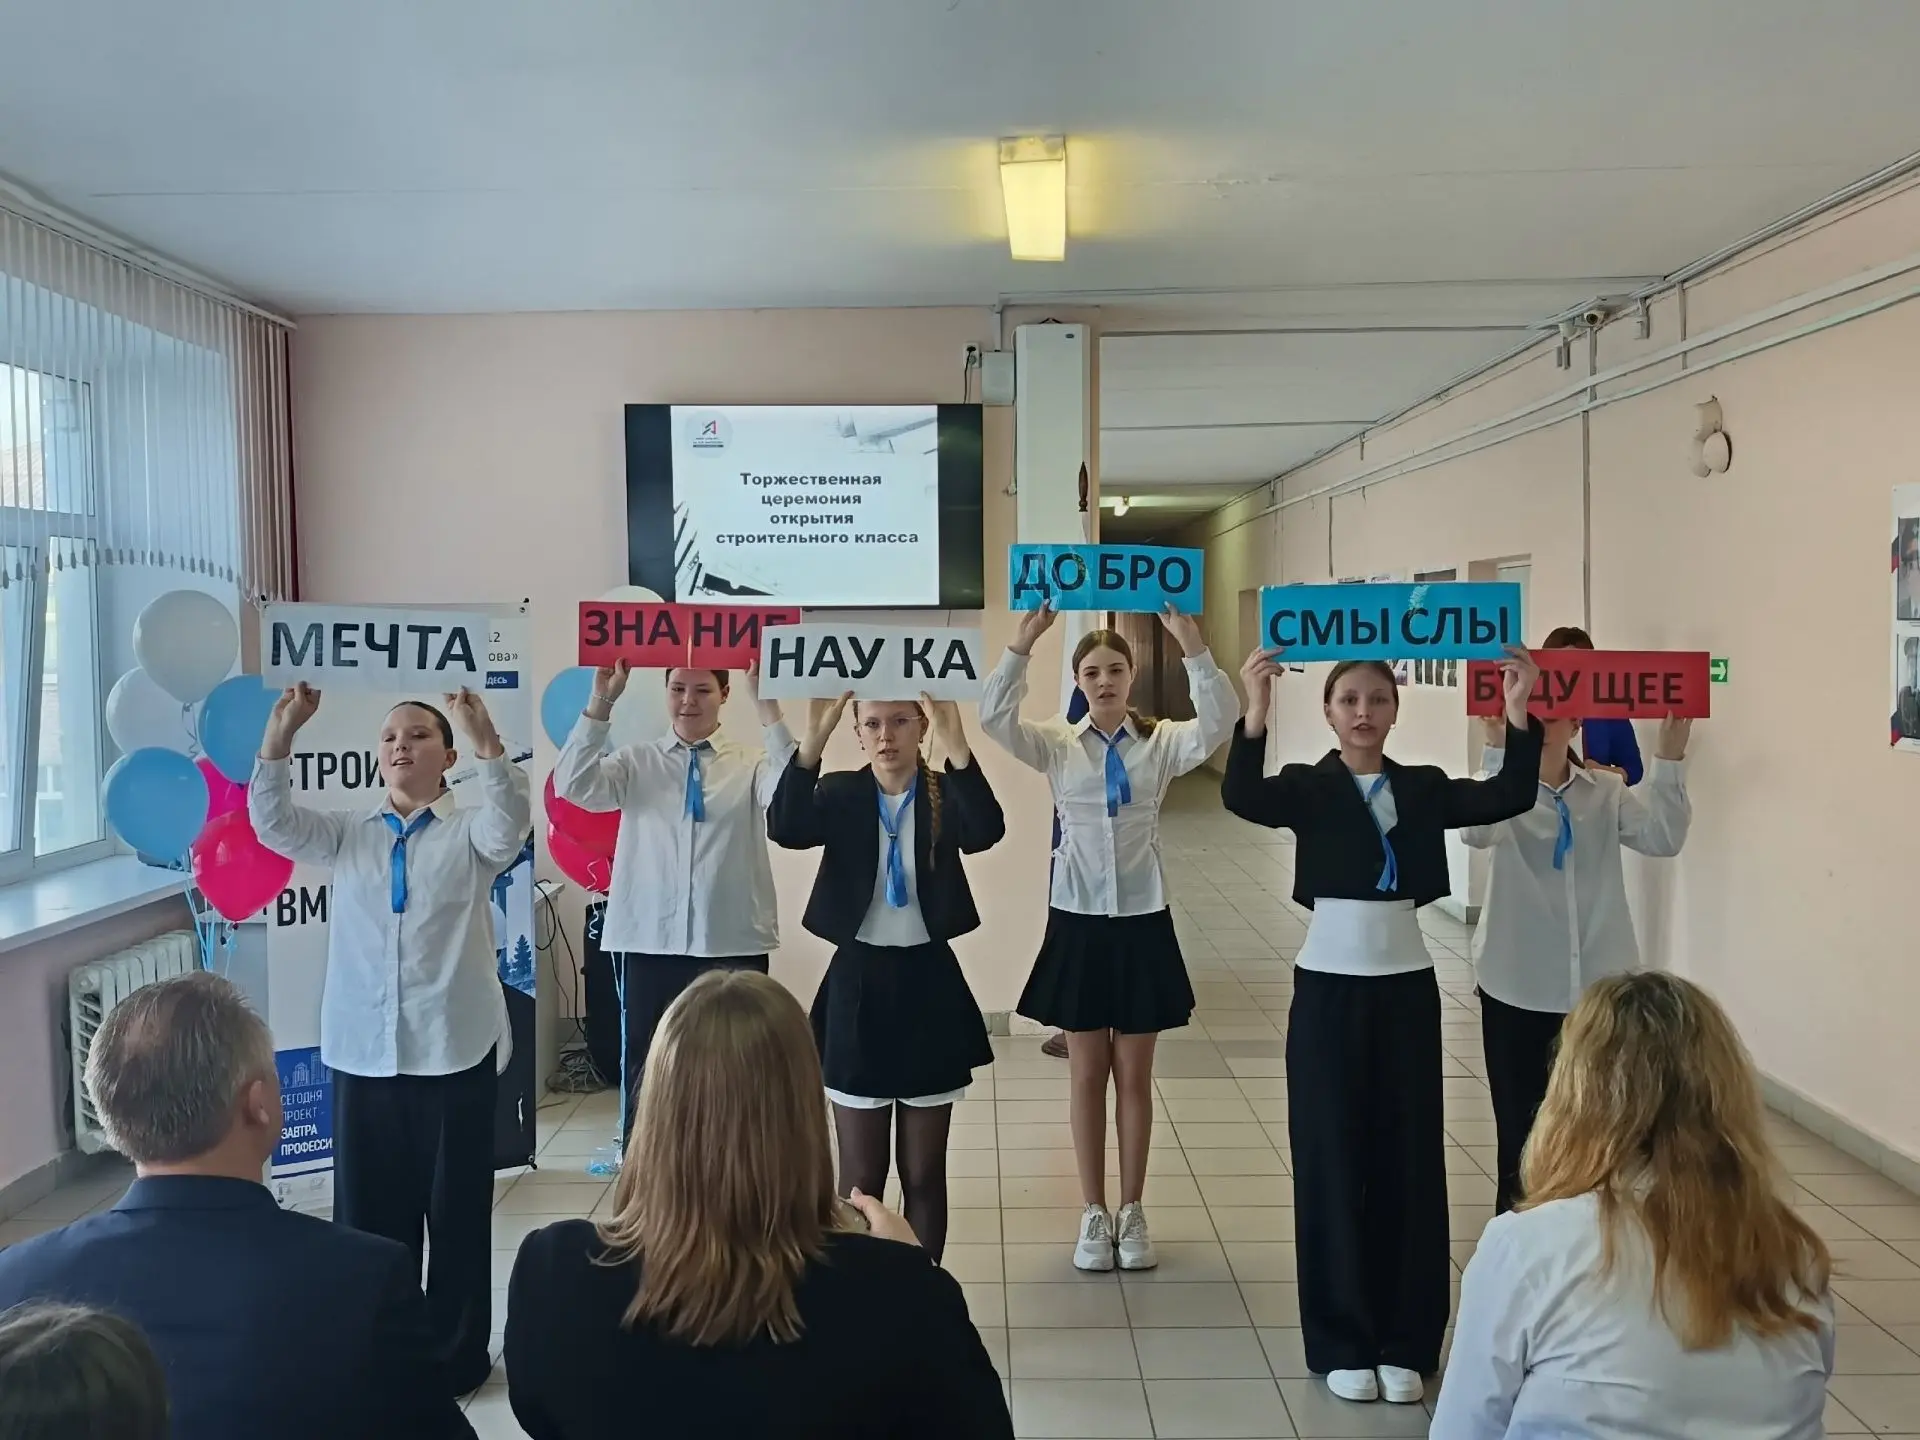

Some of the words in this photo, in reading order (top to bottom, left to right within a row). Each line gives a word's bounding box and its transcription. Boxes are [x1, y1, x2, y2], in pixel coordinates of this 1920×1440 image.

[740, 472, 882, 489] Торжественная
[761, 493, 861, 507] церемония
[770, 513, 854, 528] открытия
[716, 531, 849, 546] строительного
[854, 532, 919, 544] класса
[271, 621, 477, 672] МЕЧТА
[1474, 669, 1685, 711] БДУЩЕЕ
[289, 750, 385, 791] ТРОИ
[280, 1089, 323, 1106] СЕГОДНЯ
[281, 1124, 318, 1140] ЗАВТРА
